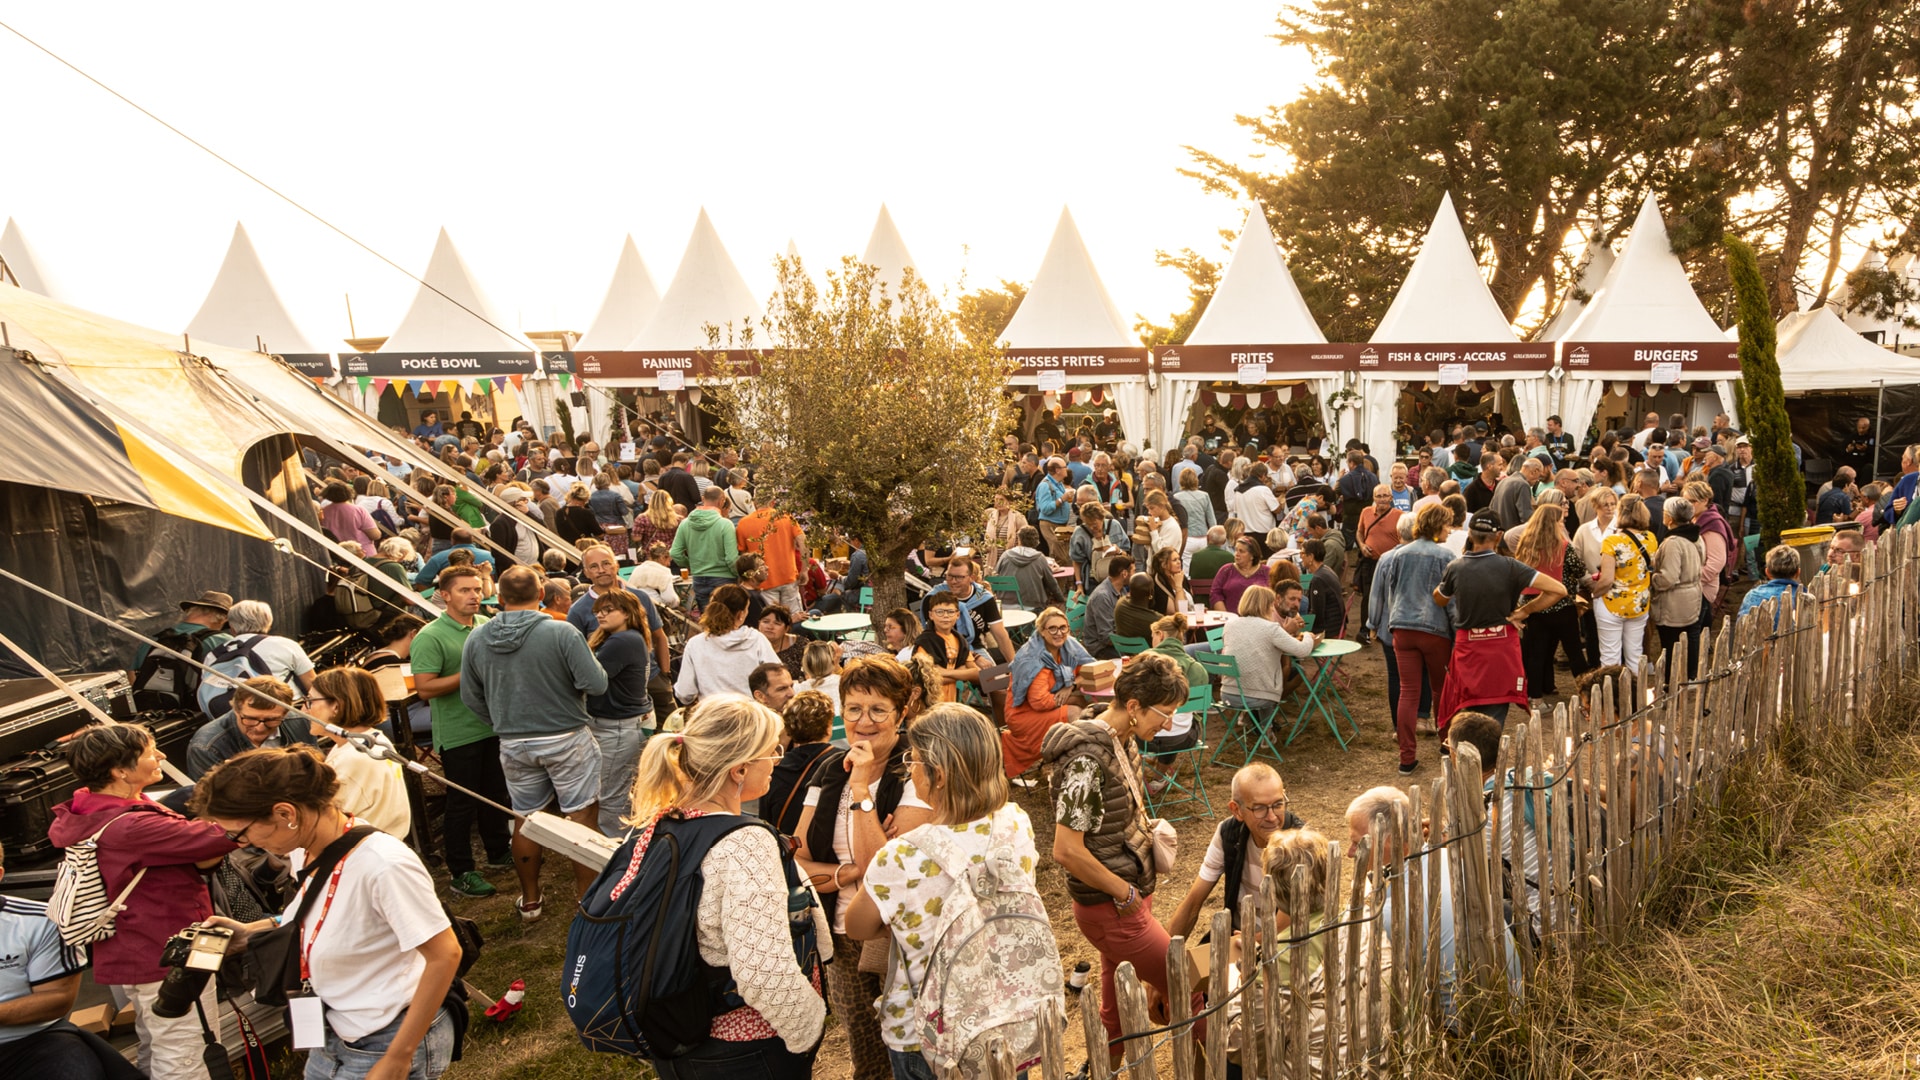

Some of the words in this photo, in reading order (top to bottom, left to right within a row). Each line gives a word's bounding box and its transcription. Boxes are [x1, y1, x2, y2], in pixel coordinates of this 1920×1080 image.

[1062, 355, 1105, 366] FRITES
[1231, 352, 1274, 364] FRITES
[1388, 352, 1411, 361] FISH
[1413, 352, 1422, 361] &
[1424, 352, 1456, 361] CHIPS
[1463, 352, 1507, 361] ACCRAS
[1634, 350, 1698, 361] BURGERS
[401, 357, 438, 369] POKÉ
[441, 358, 481, 368] BOWL
[642, 357, 693, 369] PANINIS
[568, 954, 586, 1008] Oxsitis
